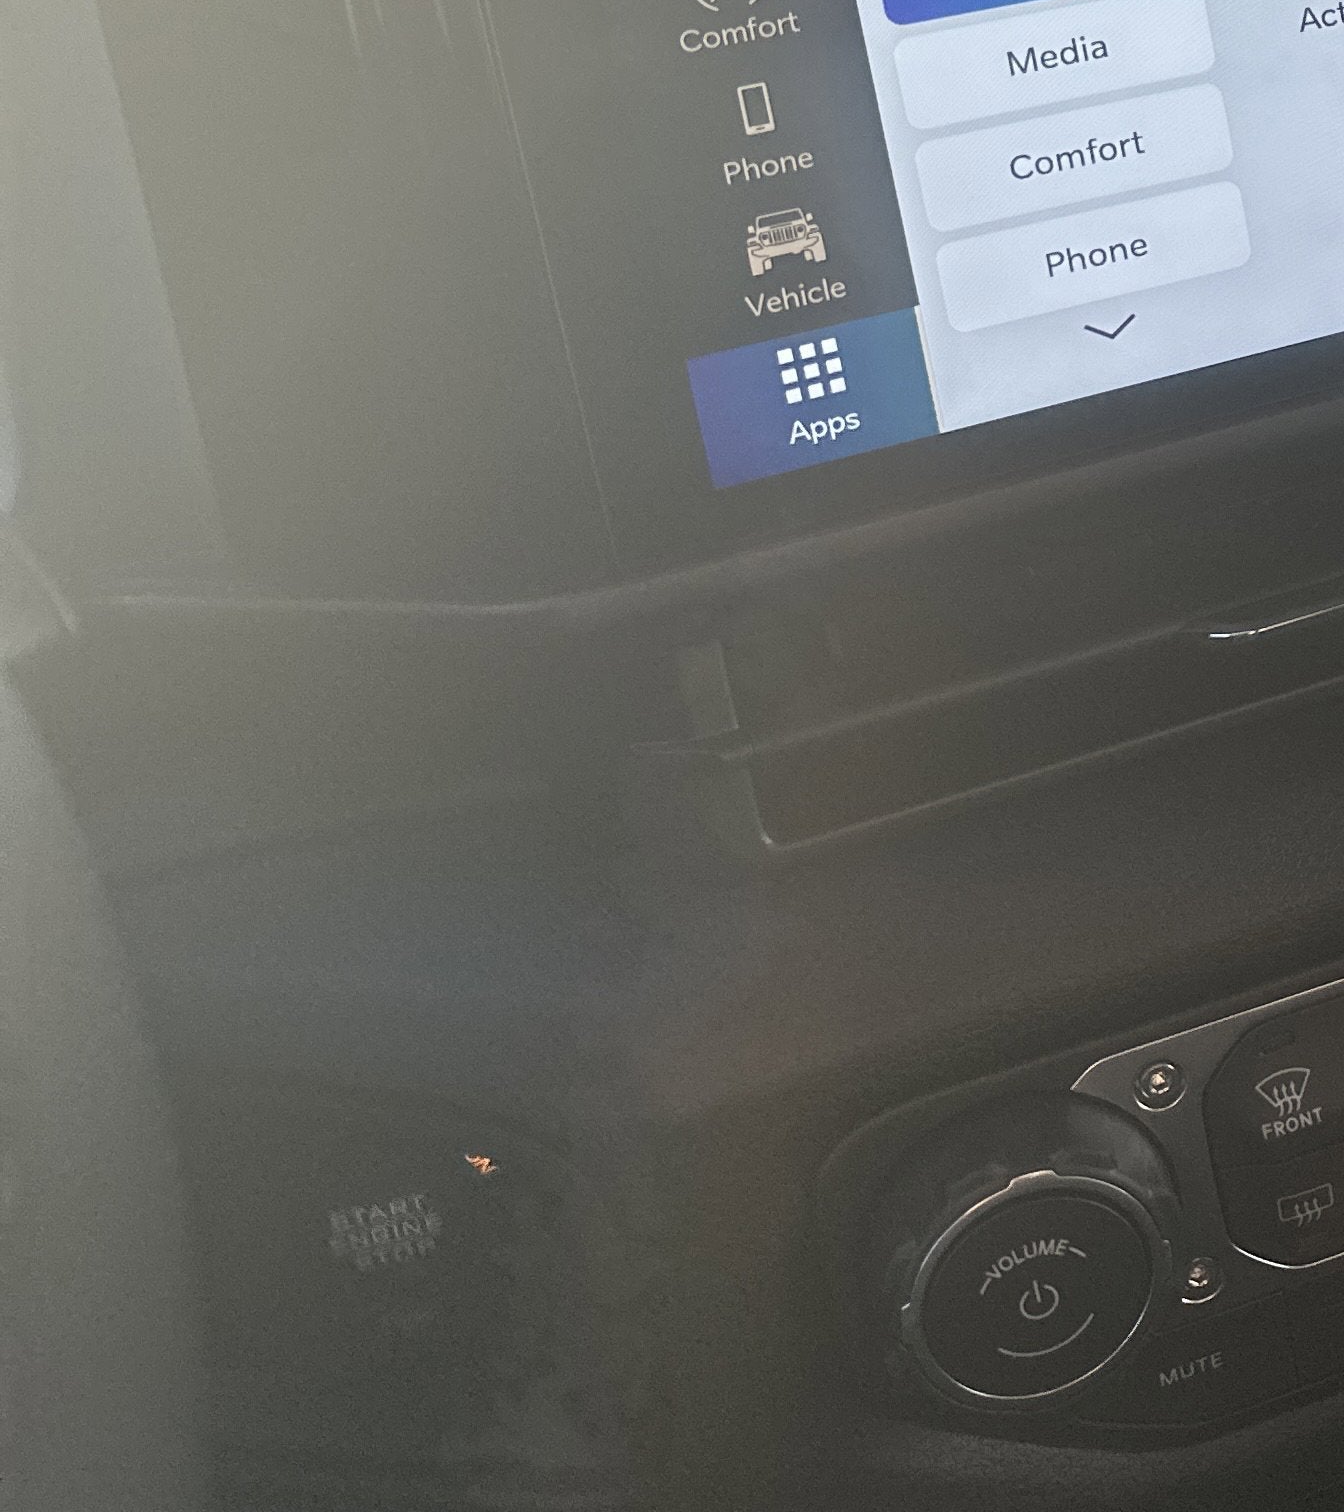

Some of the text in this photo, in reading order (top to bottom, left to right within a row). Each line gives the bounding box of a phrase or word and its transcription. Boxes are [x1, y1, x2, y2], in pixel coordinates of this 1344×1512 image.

[679, 11, 801, 54] Comfort
[1005, 33, 1109, 77] Media
[723, 148, 814, 185] Phone
[1009, 130, 1146, 181] Comfort
[1044, 233, 1149, 278] Phone
[744, 277, 848, 318] Vehicle
[787, 409, 861, 446] Apps
[1261, 1107, 1324, 1140] FRONT
[986, 1238, 1070, 1282] VOLUME
[1159, 1351, 1225, 1387] MUTE
